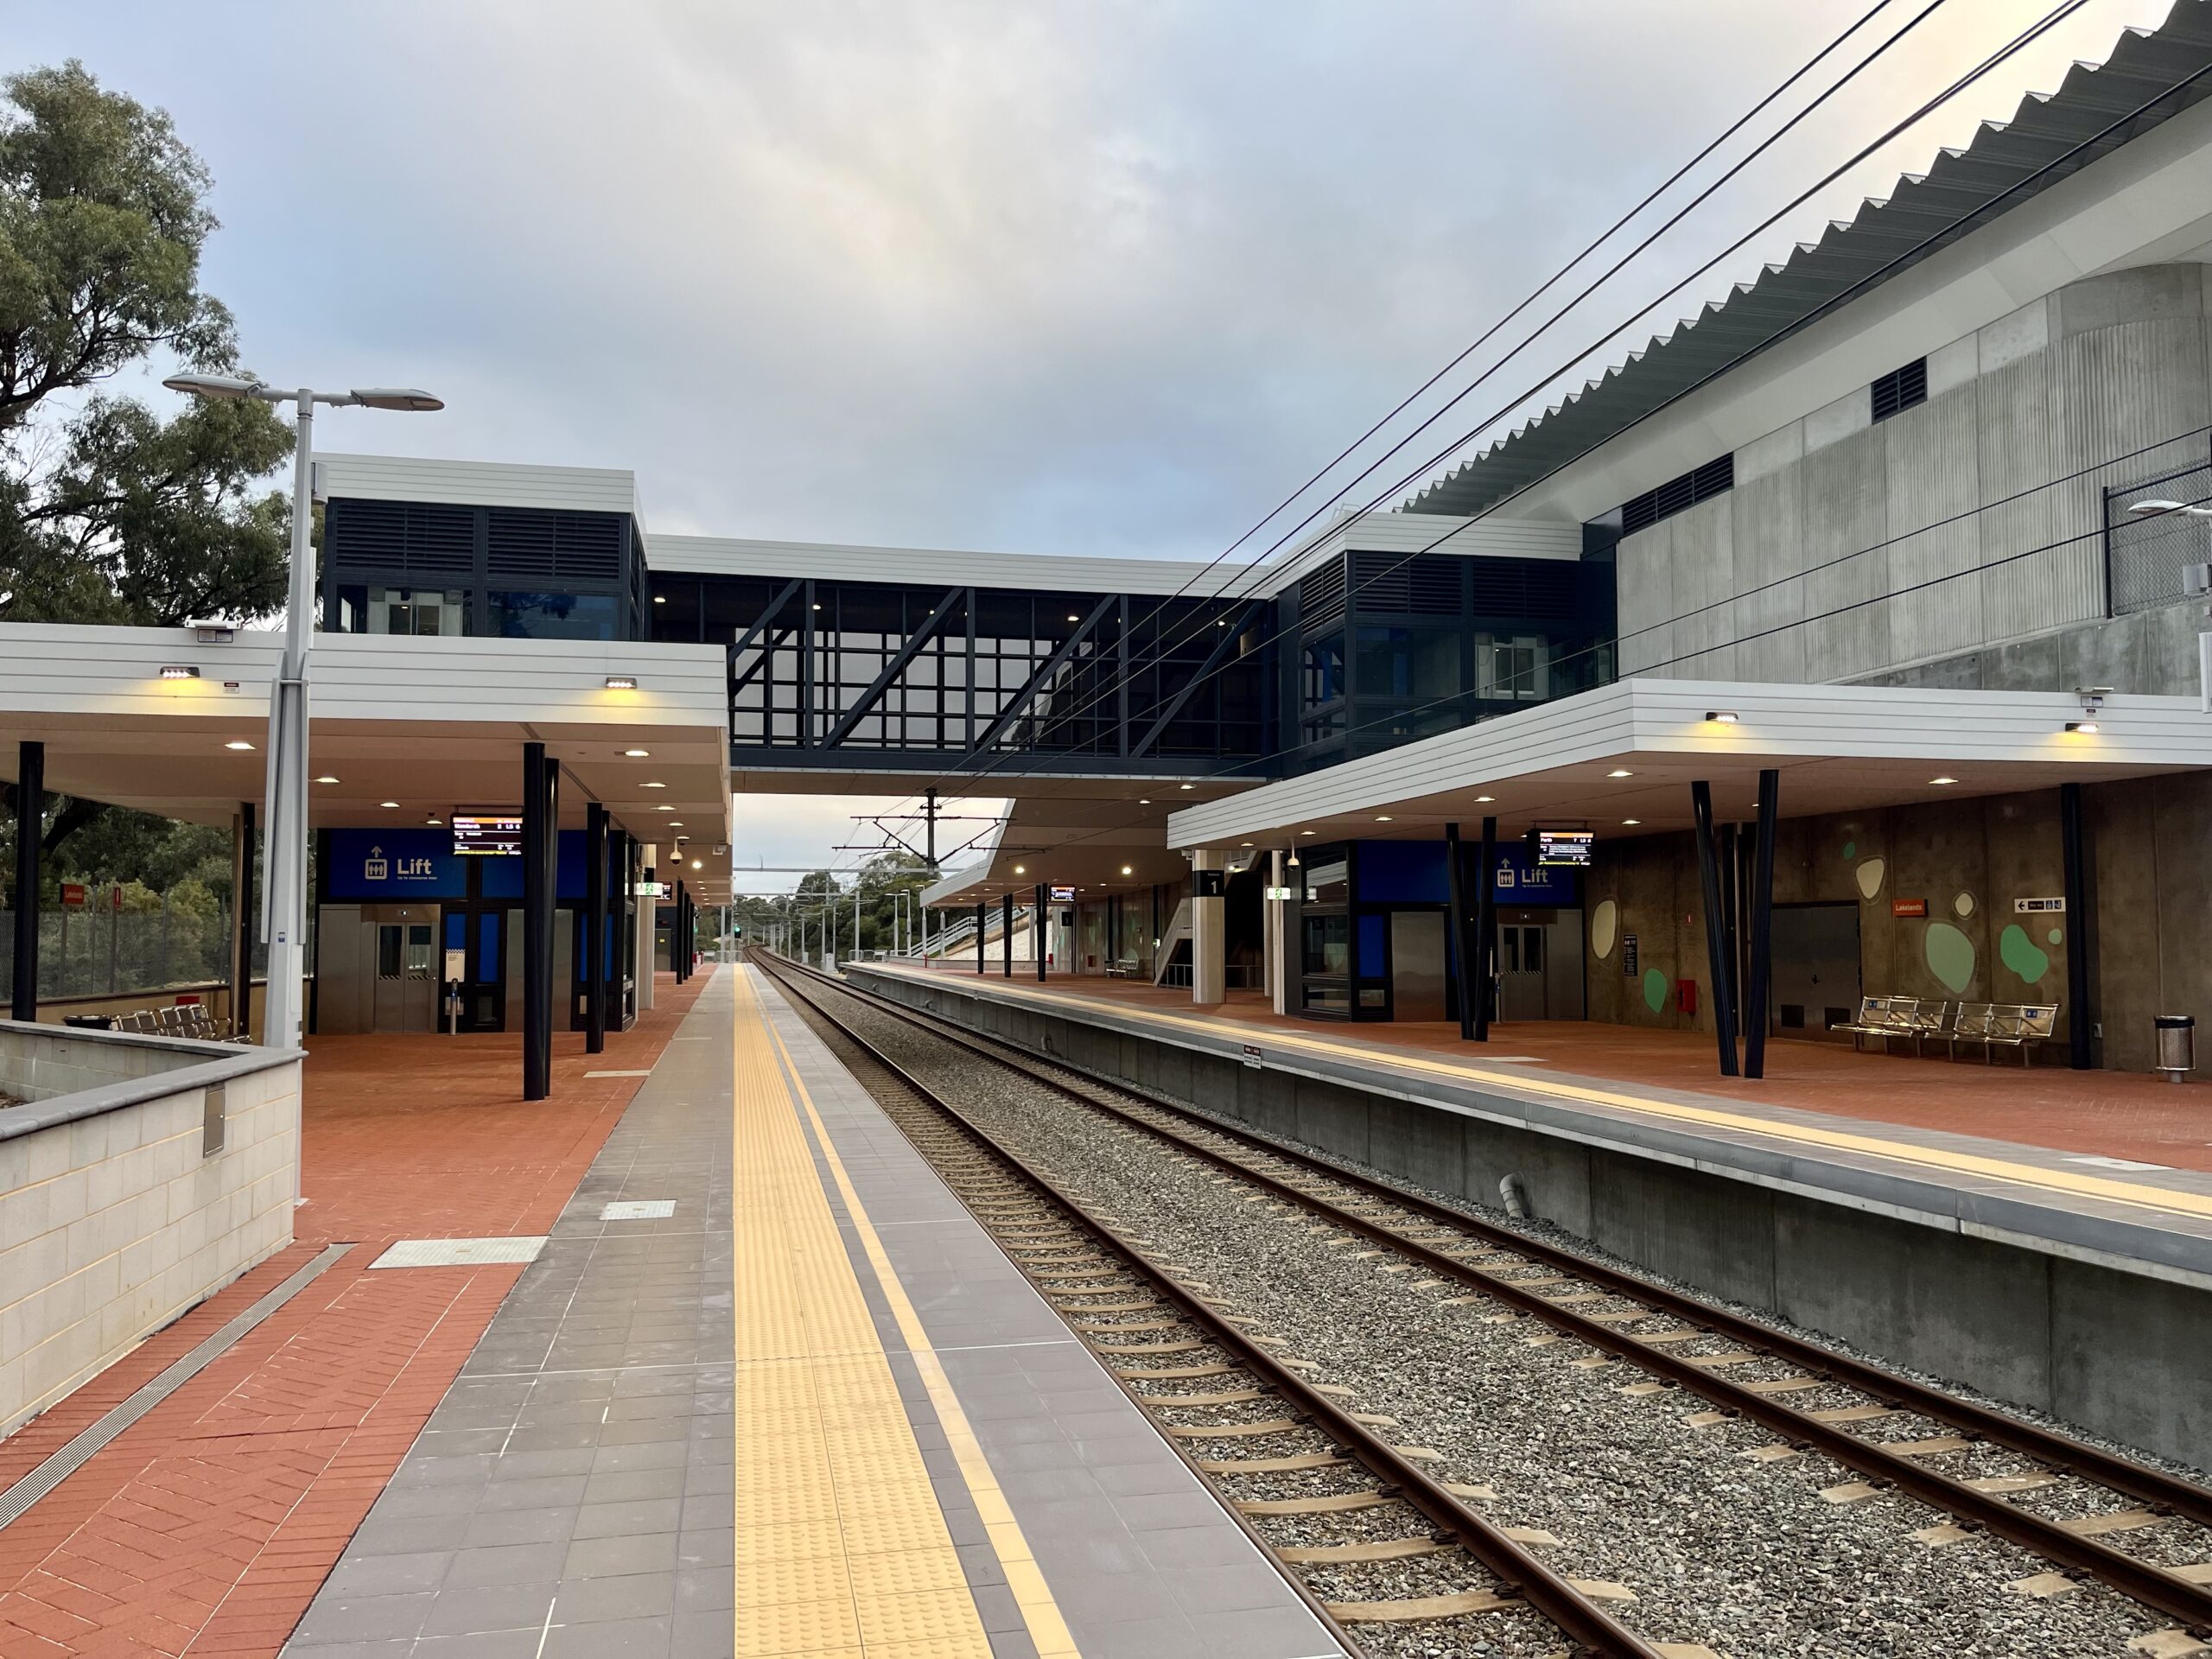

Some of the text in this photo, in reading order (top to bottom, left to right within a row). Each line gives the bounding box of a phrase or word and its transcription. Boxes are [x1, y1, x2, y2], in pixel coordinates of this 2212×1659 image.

[397, 858, 432, 874] Lift
[1522, 869, 1548, 883] Lift
[1211, 880, 1217, 894] 1
[1895, 903, 1923, 912] Lakelands
